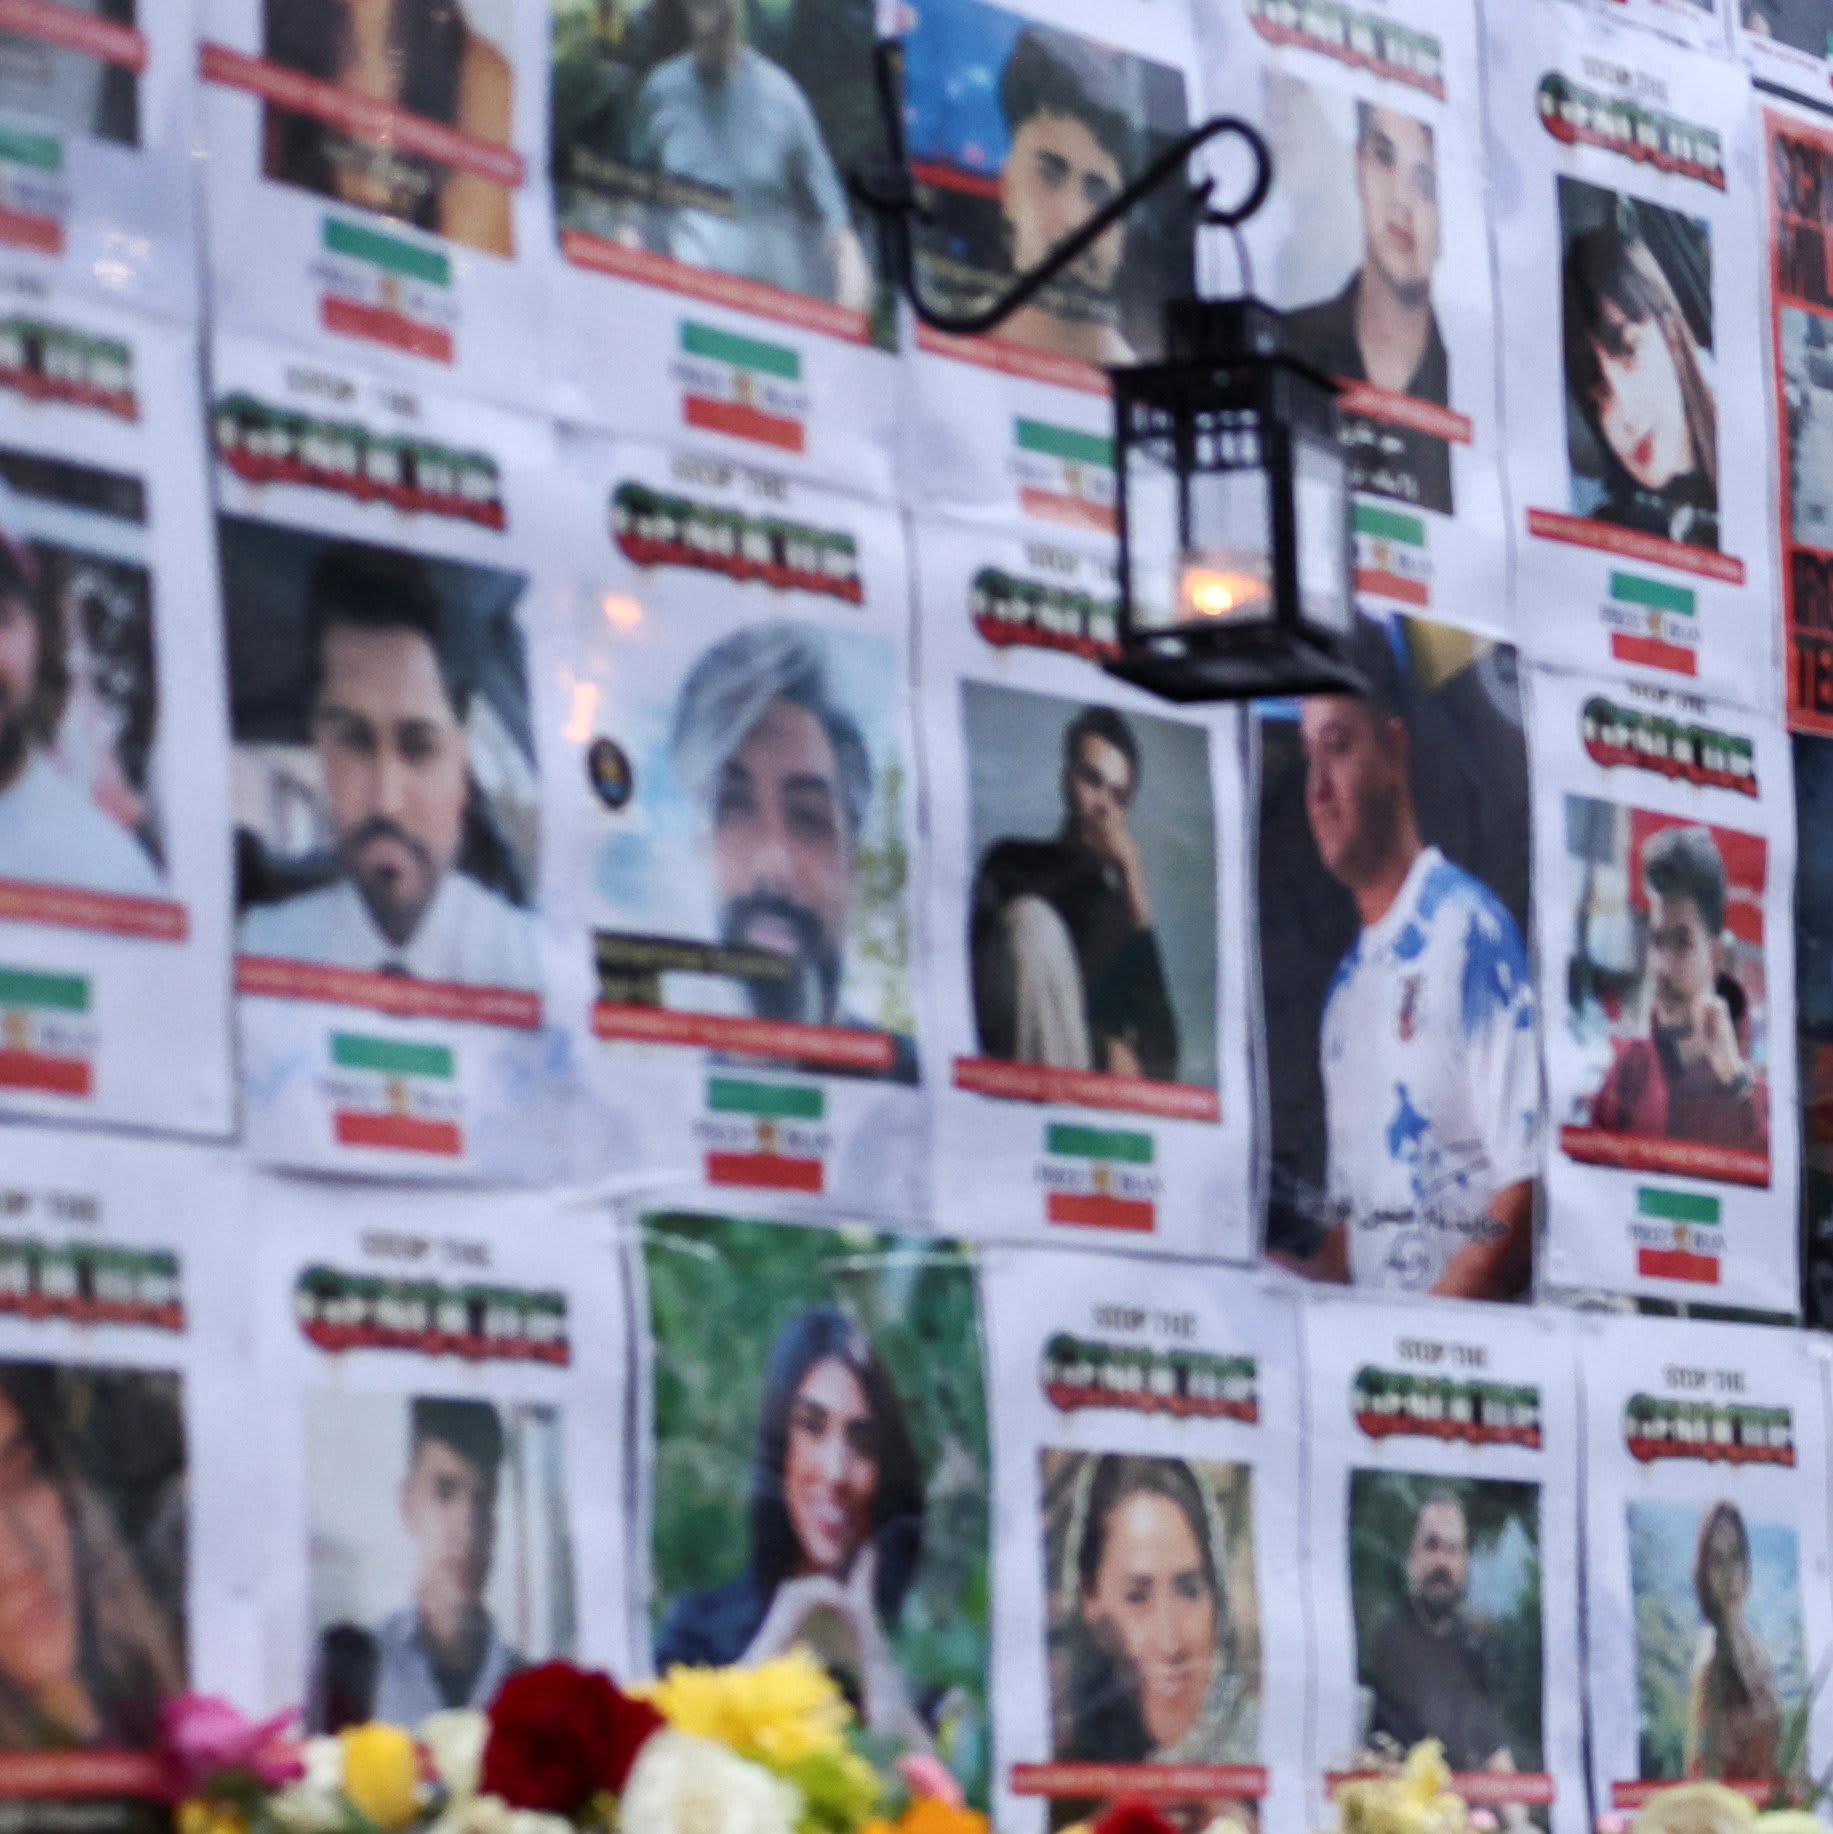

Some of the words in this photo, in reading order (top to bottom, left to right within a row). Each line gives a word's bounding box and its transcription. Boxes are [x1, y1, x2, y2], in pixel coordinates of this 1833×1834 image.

[1397, 1338, 1448, 1366] STOP
[1453, 1342, 1489, 1370] THE
[1664, 1364, 1710, 1391] STOP
[1715, 1370, 1747, 1394] THE
[1353, 1364, 1544, 1450] GENOCIDE
[1626, 1393, 1795, 1467] GENOCIDE
